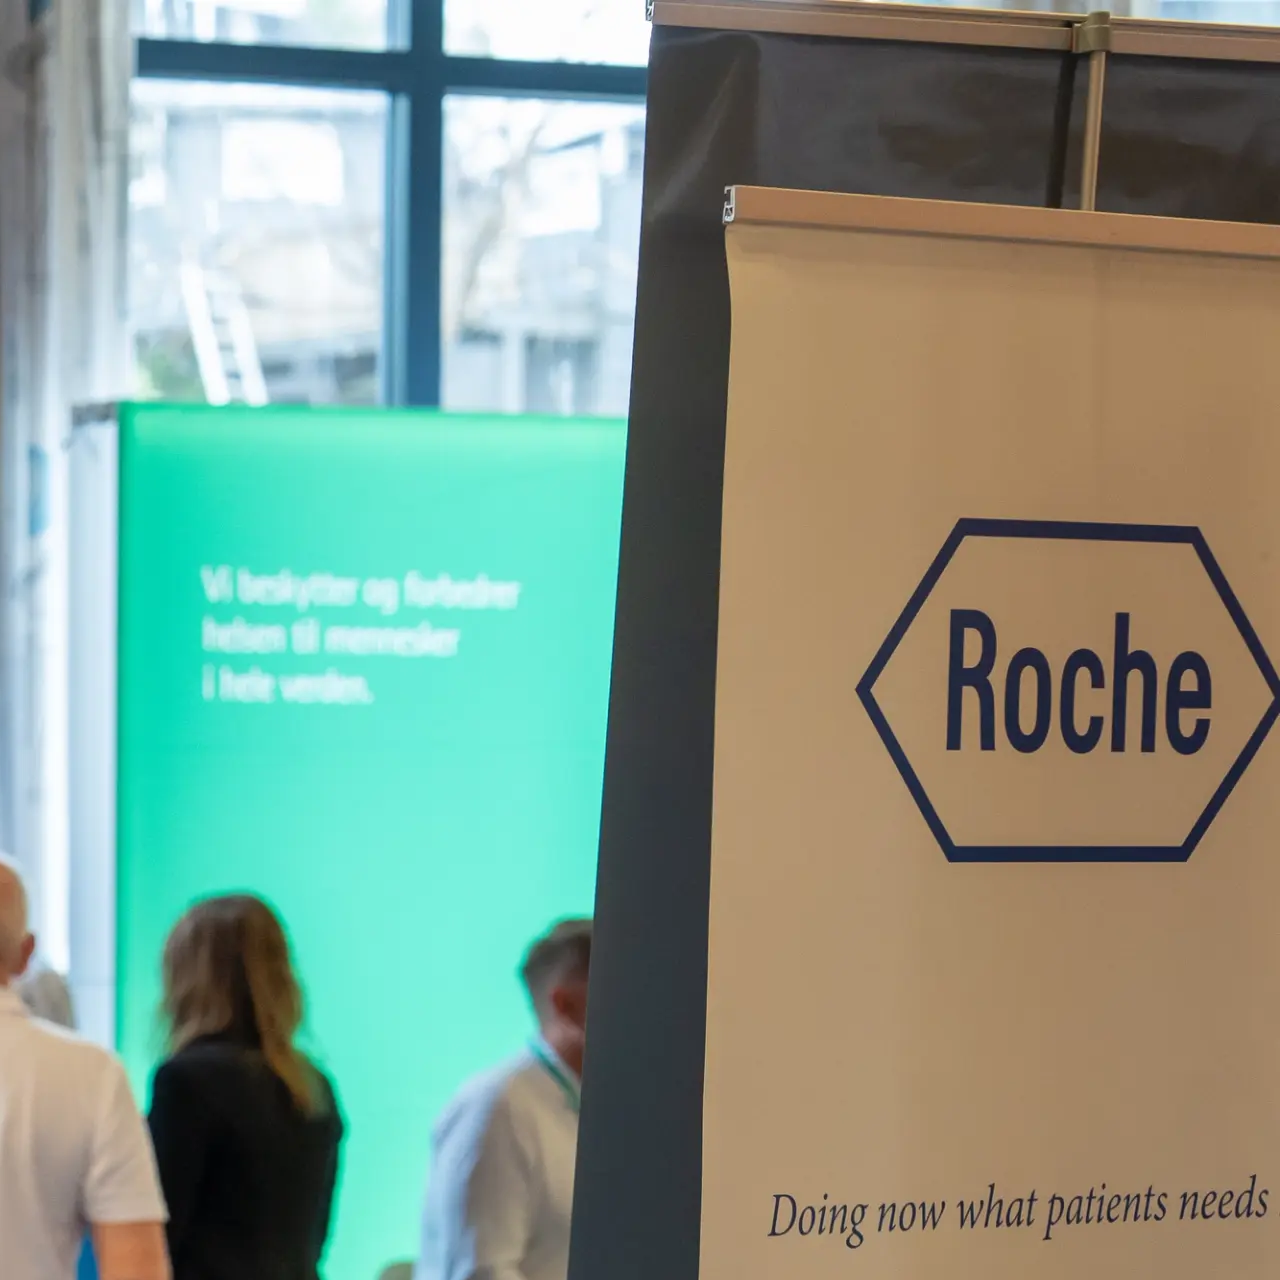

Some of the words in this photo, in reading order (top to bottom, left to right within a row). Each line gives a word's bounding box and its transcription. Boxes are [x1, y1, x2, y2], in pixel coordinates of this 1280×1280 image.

[946, 608, 1212, 755] Roche
[767, 1193, 869, 1249] Doing
[877, 1200, 946, 1232] now
[956, 1182, 1038, 1230] what
[1042, 1183, 1168, 1241] patients
[1179, 1174, 1270, 1222] needs
